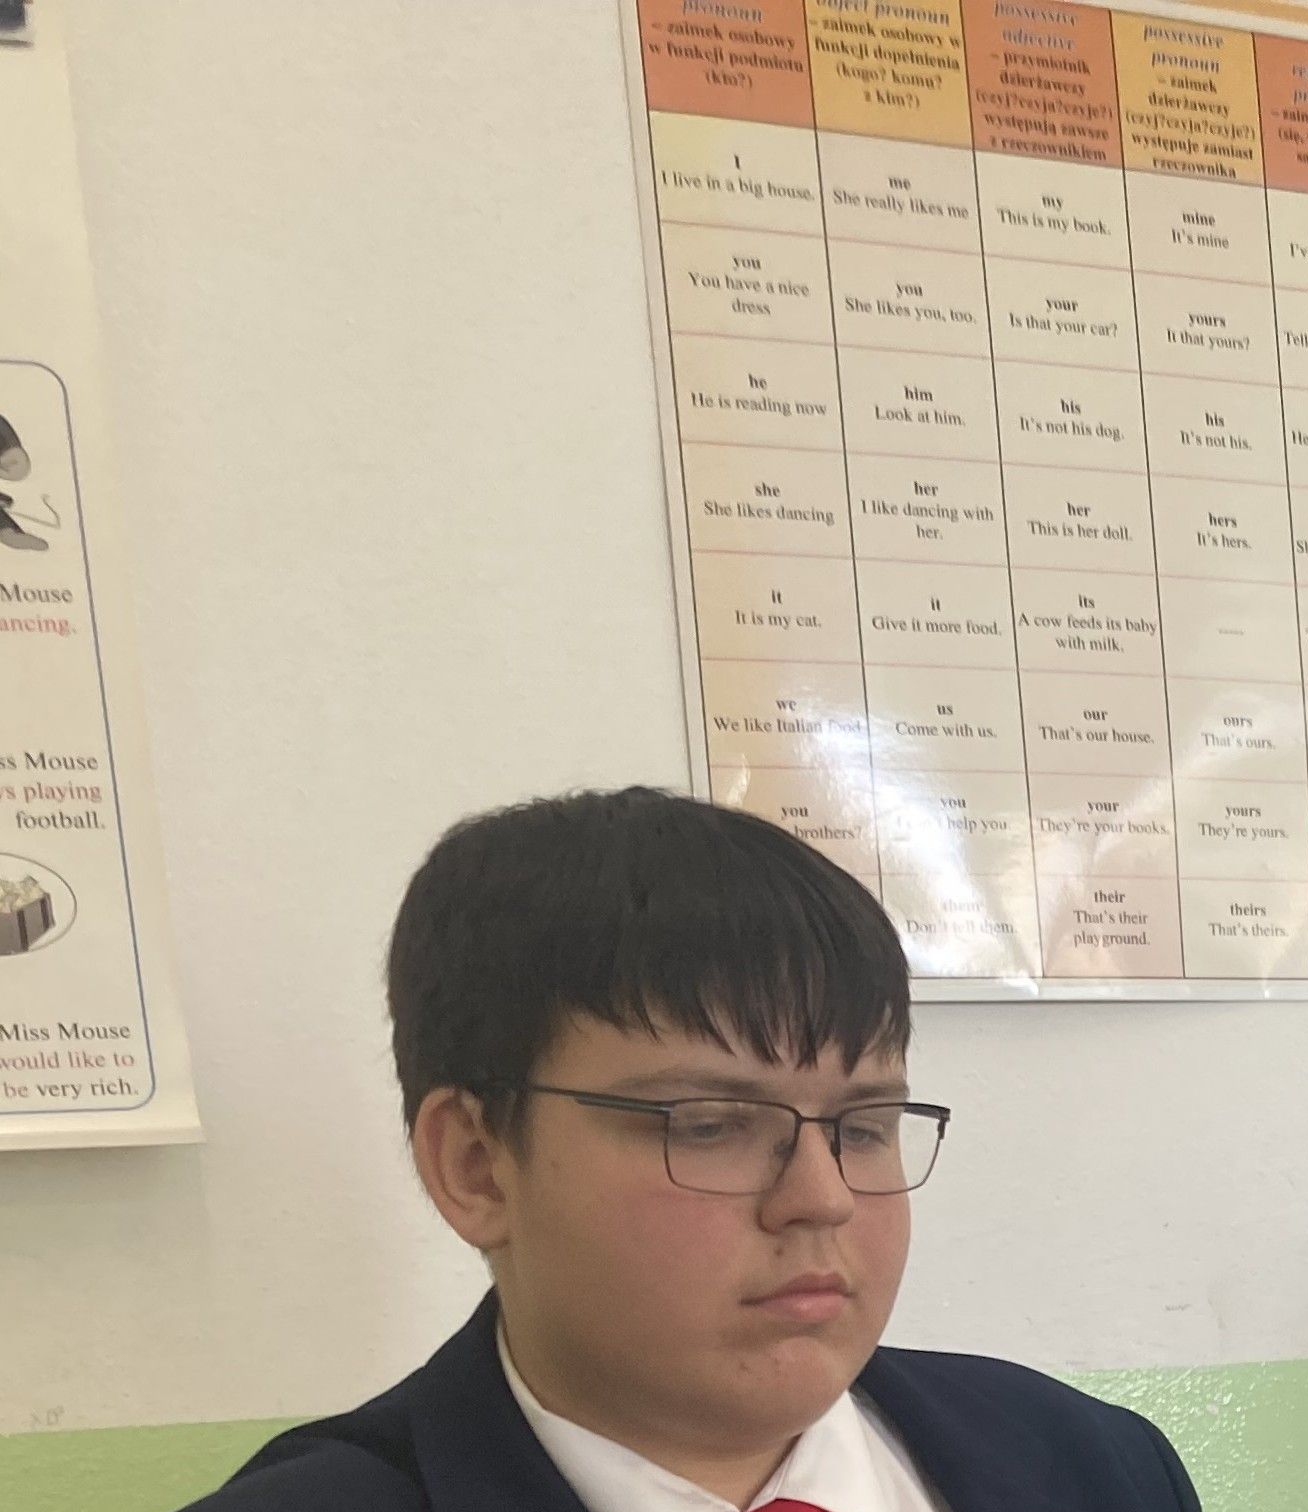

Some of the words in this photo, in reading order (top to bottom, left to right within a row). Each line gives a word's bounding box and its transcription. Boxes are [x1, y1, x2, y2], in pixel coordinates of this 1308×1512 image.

[734, 154, 740, 170] I
[661, 169, 668, 186] I
[673, 170, 702, 190] live
[706, 174, 721, 191] in
[726, 179, 735, 193] a
[738, 177, 764, 200] big
[767, 181, 815, 202] house.
[888, 177, 911, 191] me
[1042, 196, 1063, 212] my
[1182, 210, 1215, 226] mine
[1172, 228, 1194, 245] It's
[1197, 232, 1229, 249] mine
[732, 255, 761, 273] you
[688, 271, 721, 290] You
[725, 274, 761, 293] have
[765, 282, 775, 294] a
[778, 279, 809, 297] nice
[896, 283, 923, 300] you
[731, 297, 771, 316] dress
[1046, 299, 1079, 315] your
[1009, 312, 1022, 329] Is
[1025, 314, 1051, 332] that
[1055, 320, 1087, 338] your
[1090, 320, 1118, 338] car?
[1188, 314, 1226, 330] yours
[1180, 329, 1204, 346] that
[1208, 333, 1250, 353] yours?
[748, 373, 767, 390] he
[904, 385, 933, 402] him
[691, 391, 714, 409] He
[718, 394, 731, 409] is
[735, 394, 792, 418] reading
[795, 402, 826, 416] now
[1061, 398, 1081, 415] his
[875, 405, 912, 423] Look
[917, 410, 930, 424] at
[934, 410, 965, 426] him.
[1205, 411, 1224, 427] his
[755, 481, 780, 498] she
[914, 480, 939, 497] her
[703, 500, 733, 517] She
[737, 502, 772, 519] likes
[775, 505, 834, 527] dancing
[1067, 502, 1091, 518] her
[1208, 512, 1237, 528] hers
[1027, 520, 1058, 536] This
[1062, 522, 1074, 537] is
[1077, 523, 1099, 539] her
[1102, 525, 1132, 542] doll.
[771, 589, 782, 604] it
[930, 597, 940, 611] it
[1078, 594, 1095, 608] its
[871, 614, 907, 632] Give
[911, 617, 921, 633] it
[925, 621, 961, 634] more
[776, 700, 797, 712] we
[936, 704, 953, 715] us
[1083, 710, 1108, 721] our
[1223, 716, 1252, 728] ours
[1039, 725, 1082, 742] That's
[1085, 731, 1108, 743] our
[1112, 728, 1154, 744] house.
[25, 753, 98, 771] Mouse
[23, 781, 102, 804] playing
[940, 798, 966, 808] you
[1087, 801, 1120, 814] your
[16, 811, 104, 829] football.
[780, 807, 809, 821] you
[1225, 806, 1261, 819] yours
[1094, 889, 1126, 903] their
[1230, 903, 1266, 916] theirs
[1208, 921, 1249, 937] That's
[0, 1023, 50, 1041] Miss
[58, 1021, 130, 1040] Mouse
[68, 1050, 106, 1069] like
[113, 1052, 135, 1067] to
[3, 1081, 28, 1098] be
[36, 1083, 82, 1099] very
[90, 1077, 138, 1096] rich.
